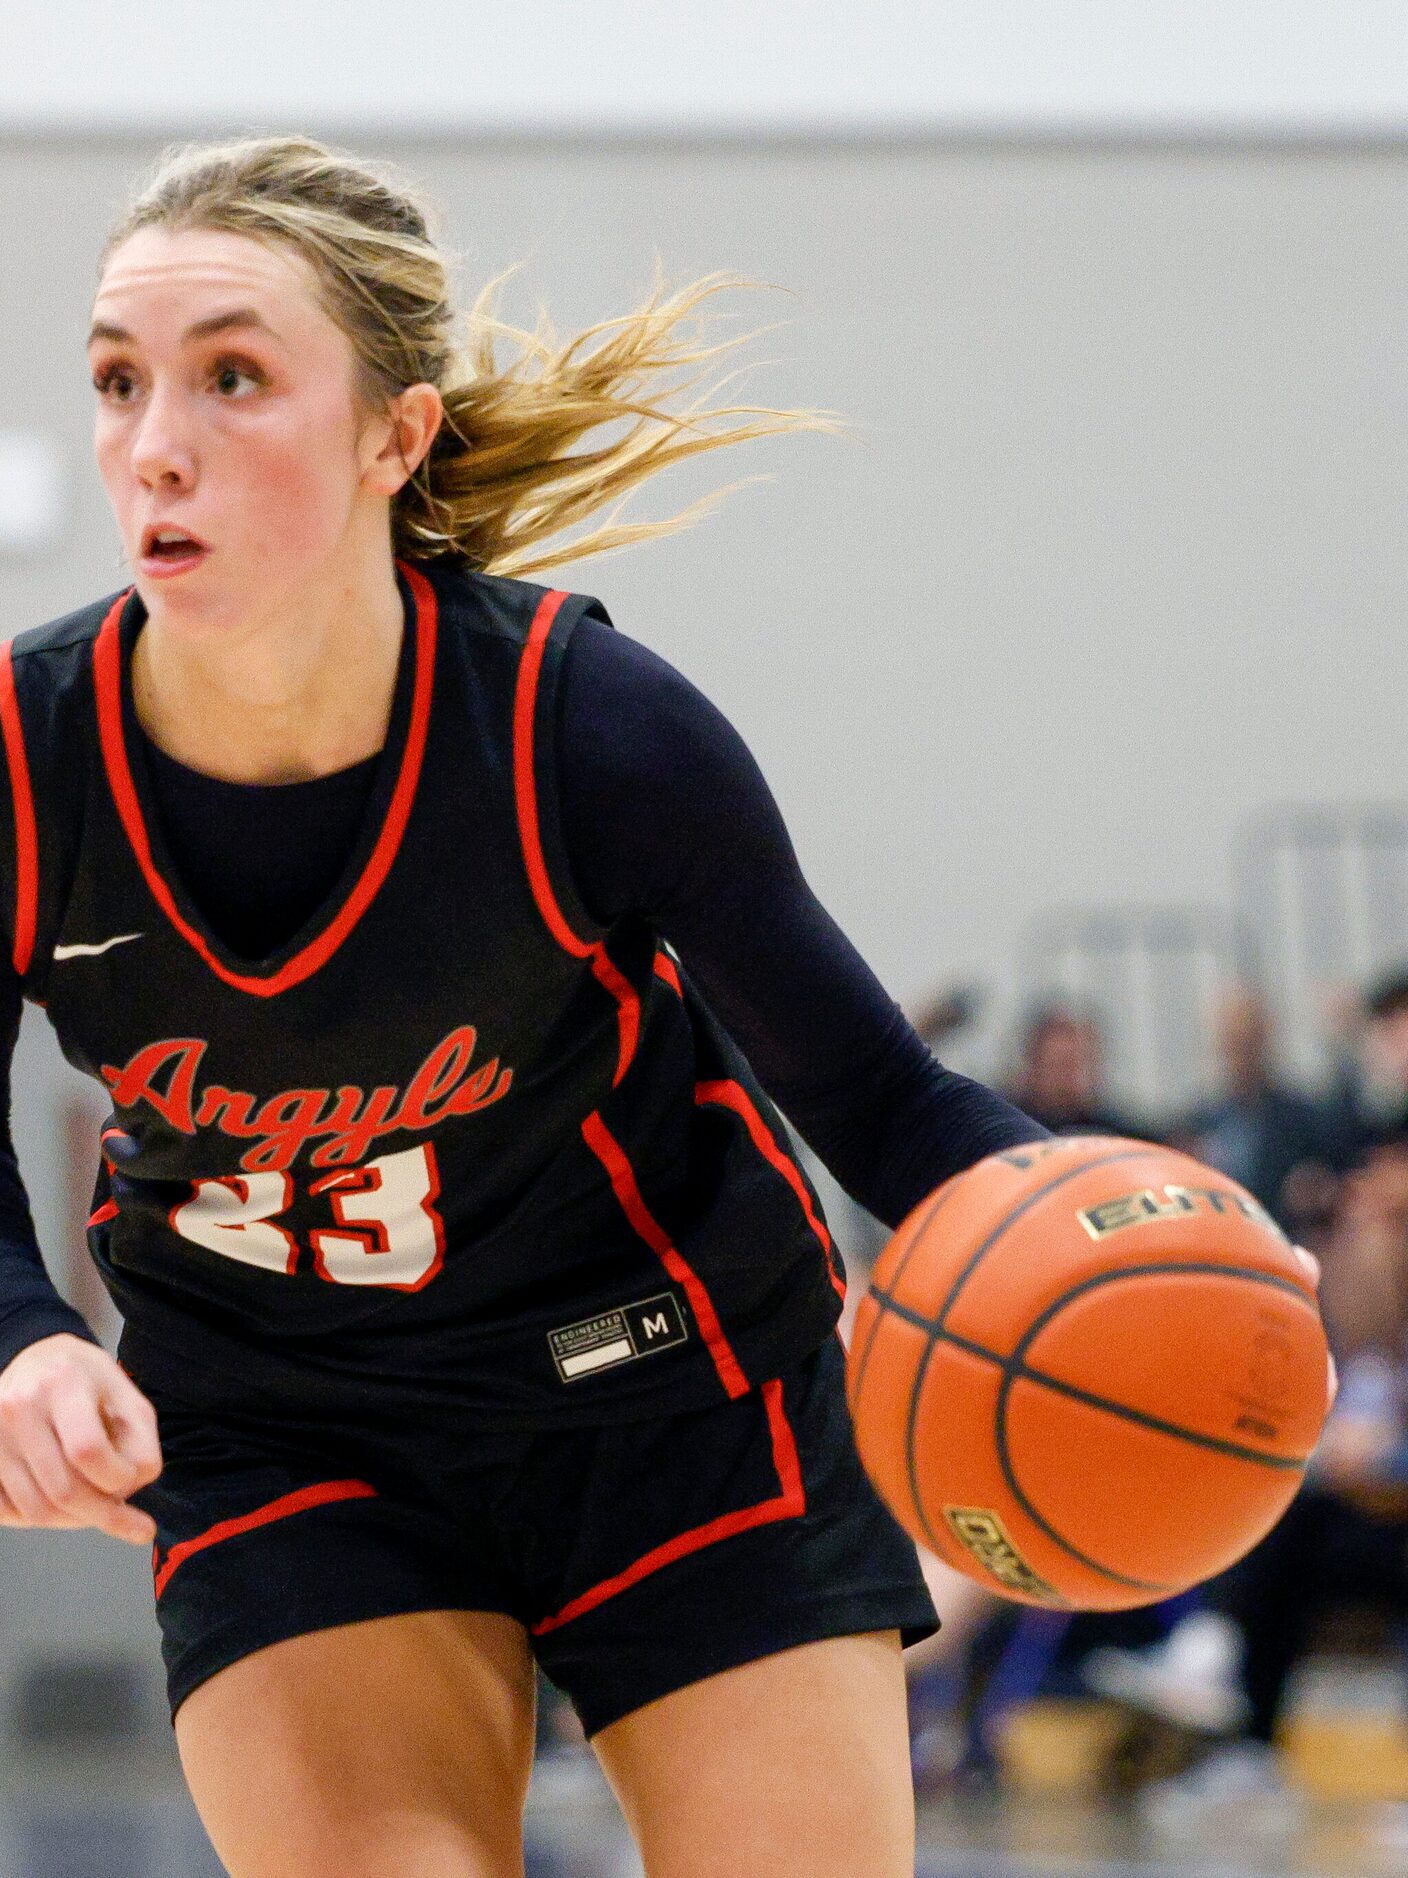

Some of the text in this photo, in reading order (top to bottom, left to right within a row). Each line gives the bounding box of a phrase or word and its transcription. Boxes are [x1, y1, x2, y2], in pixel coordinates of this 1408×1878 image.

[101, 1025, 512, 1170] Argyle
[168, 1141, 447, 1293] 23
[552, 1313, 622, 1344] ENGINEERED
[642, 1312, 669, 1339] M
